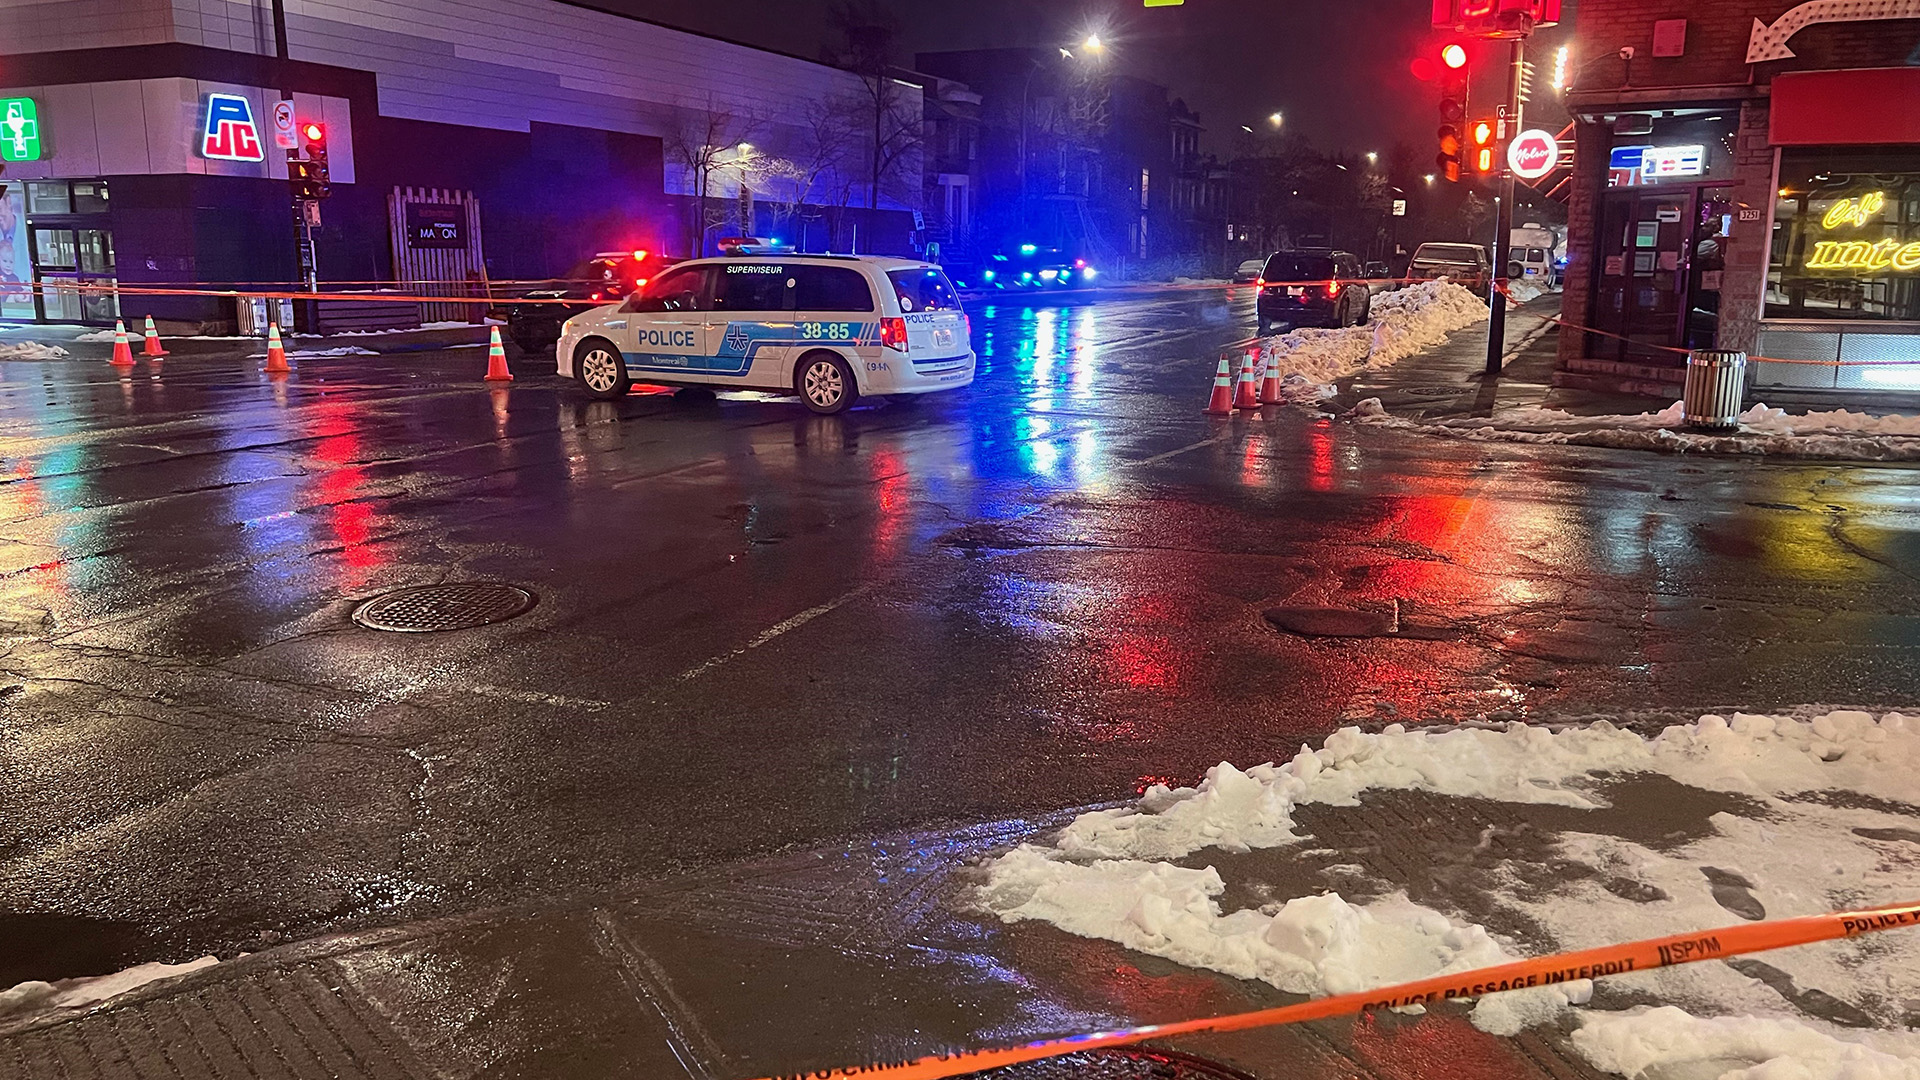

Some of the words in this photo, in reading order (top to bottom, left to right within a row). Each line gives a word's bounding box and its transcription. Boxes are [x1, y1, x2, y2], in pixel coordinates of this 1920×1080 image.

[204, 94, 264, 160] PJC
[1822, 191, 1884, 229] Café
[726, 265, 783, 274] SUPERVISEUR
[905, 313, 935, 323] POLICE
[638, 330, 695, 347] POLICE
[802, 322, 850, 339] 38-85
[1843, 914, 1907, 934] POLICE
[1445, 974, 1537, 999] PASSAGE
[1546, 958, 1635, 987] INTERDIT
